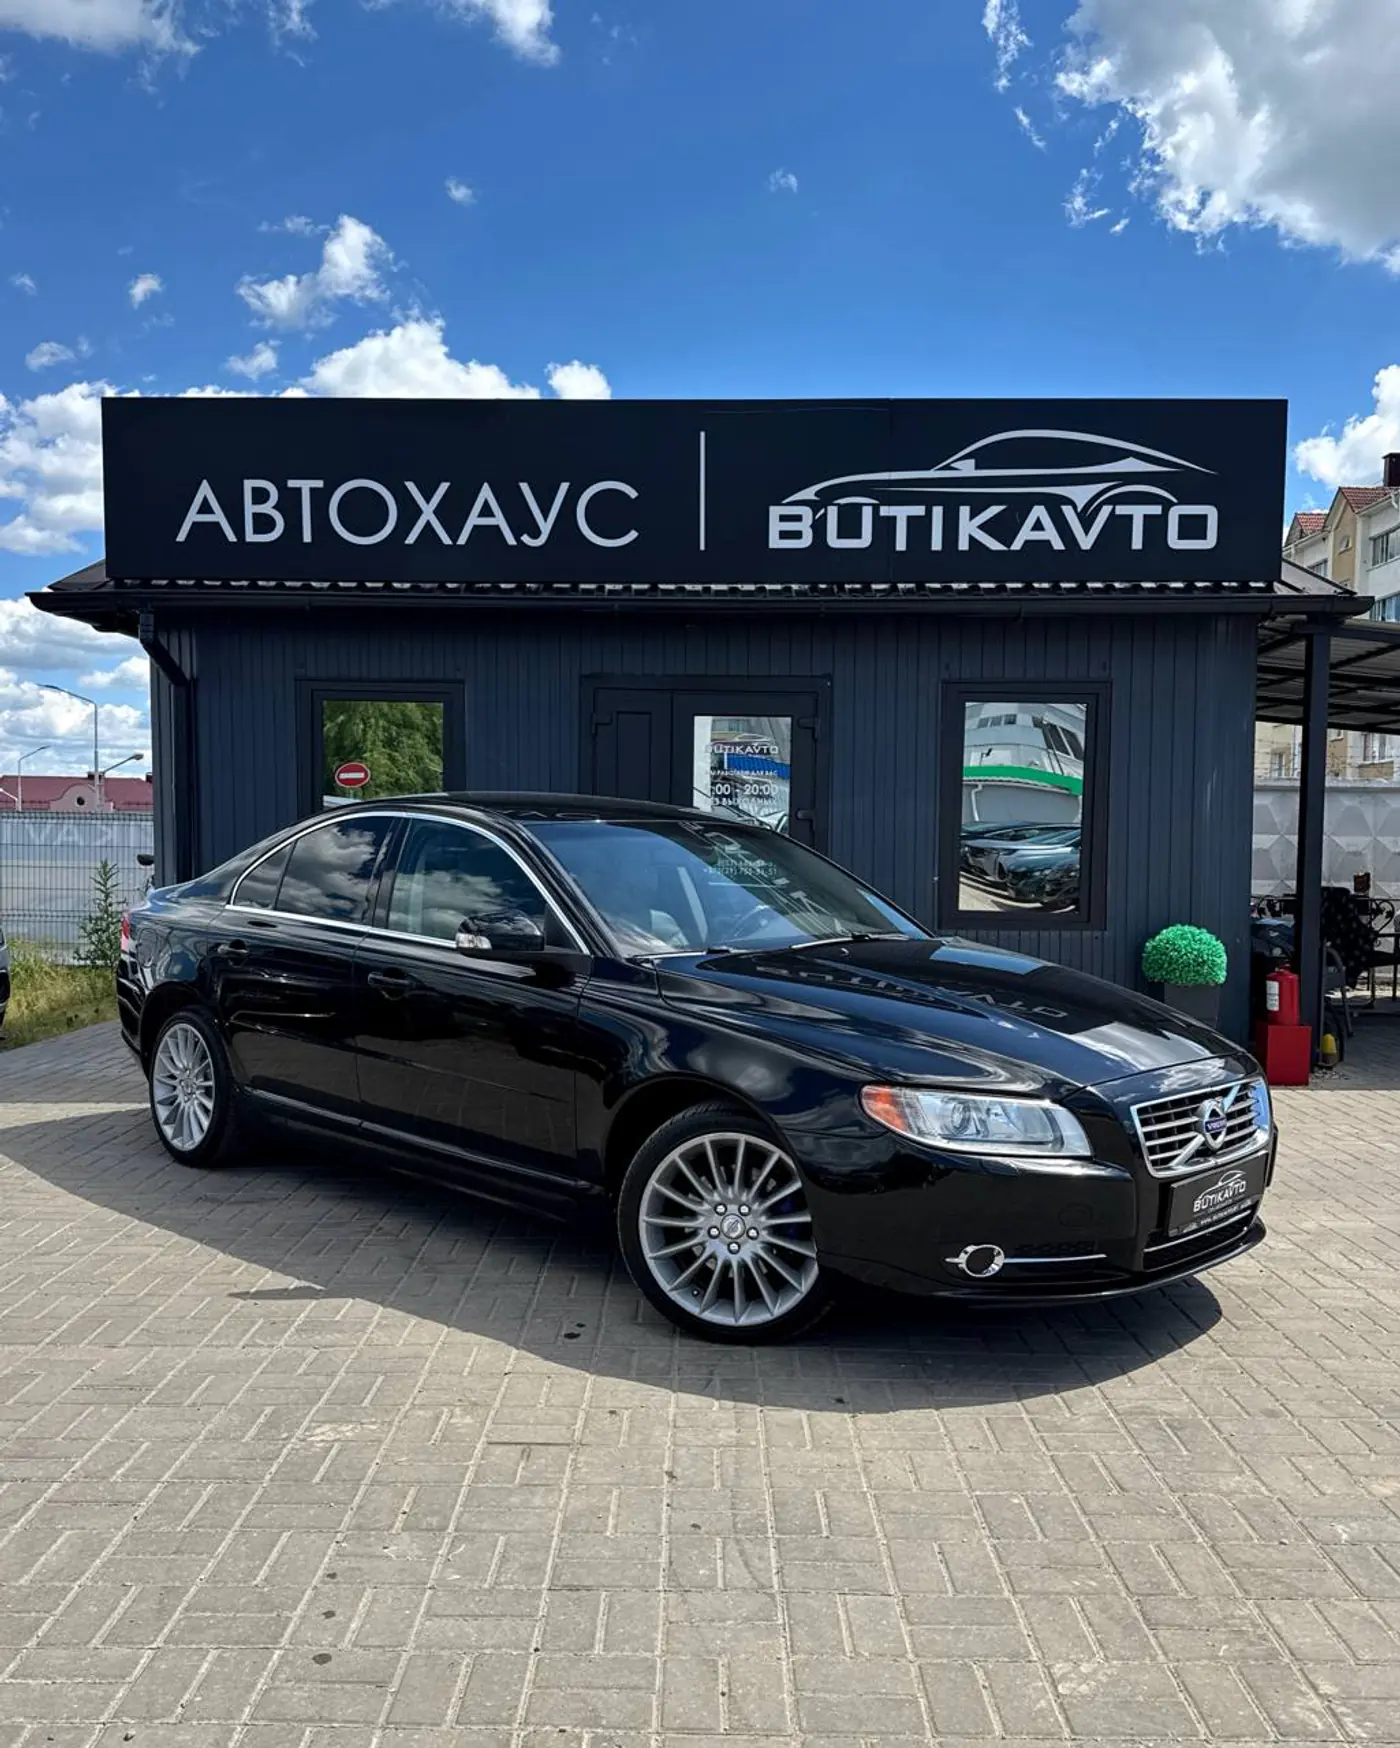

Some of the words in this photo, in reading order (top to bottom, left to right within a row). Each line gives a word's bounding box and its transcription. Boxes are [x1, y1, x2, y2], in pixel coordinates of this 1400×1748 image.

[176, 478, 639, 547] АВТОХАУС
[768, 504, 1218, 551] BUTIKAVTO
[743, 783, 779, 795] 20:00
[1193, 1181, 1247, 1213] BUTIKAVTO
